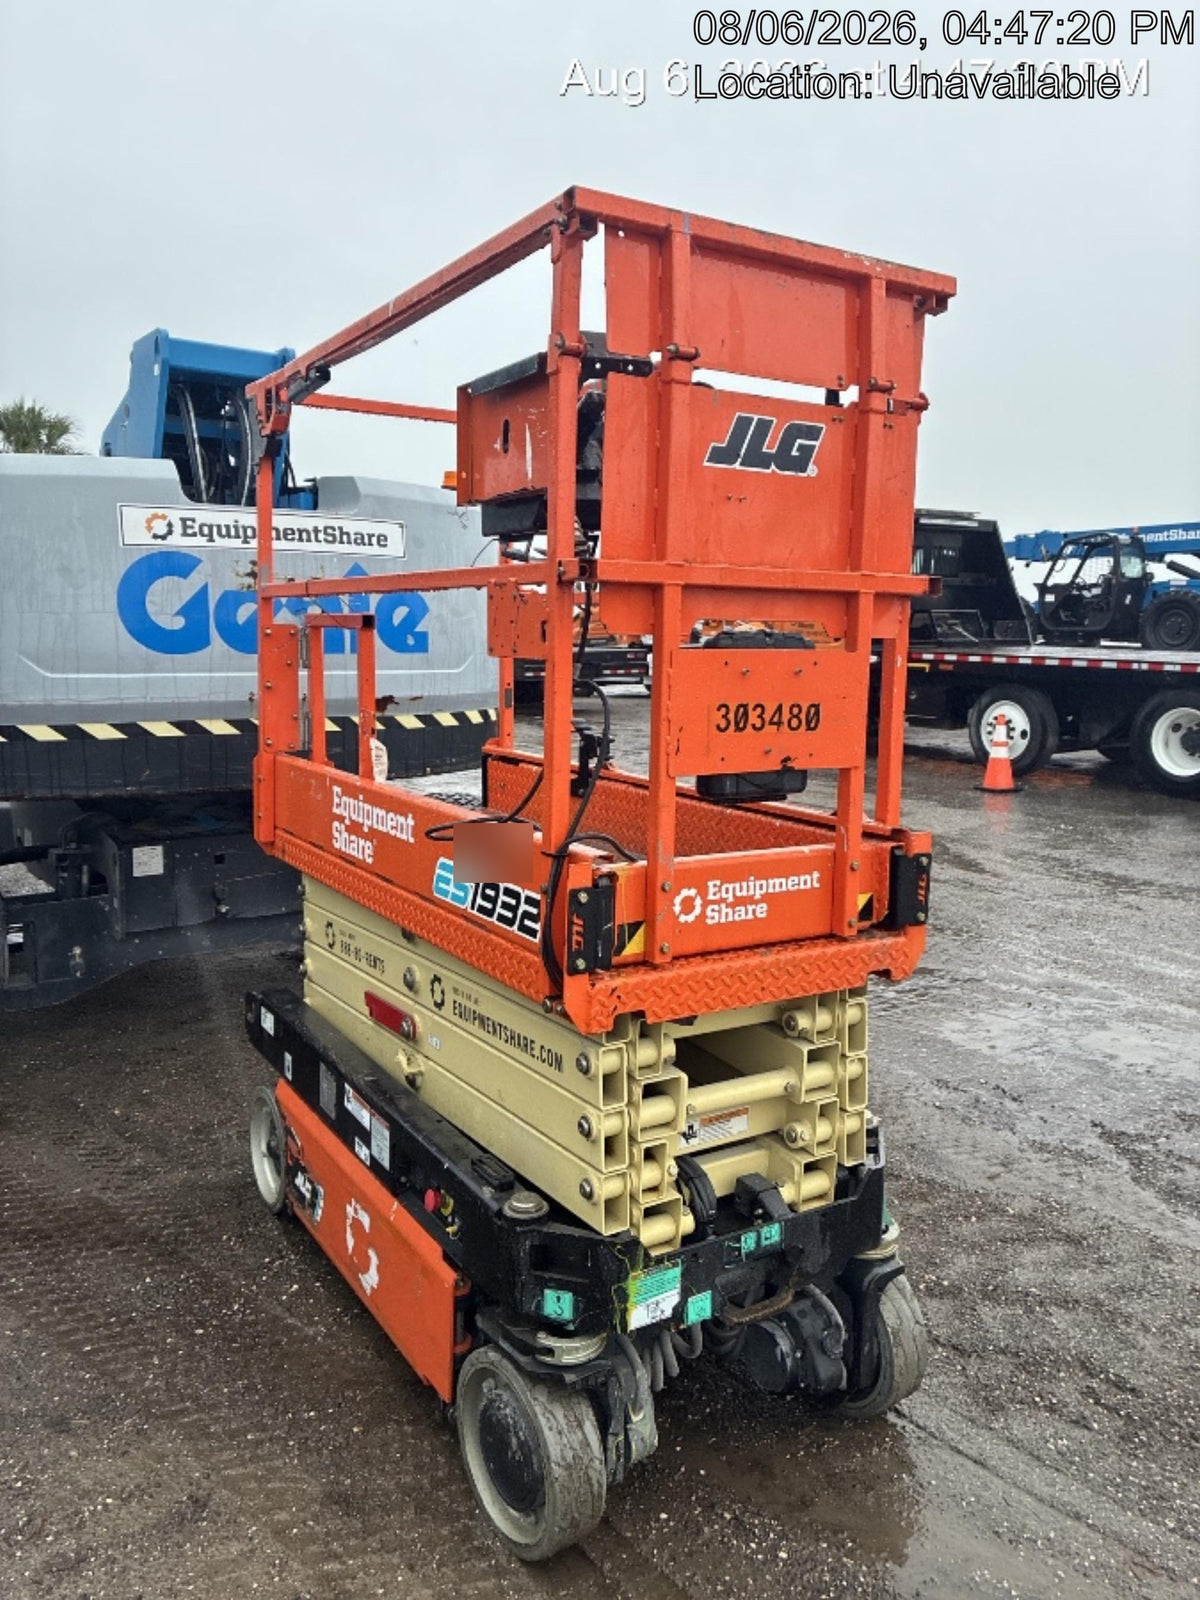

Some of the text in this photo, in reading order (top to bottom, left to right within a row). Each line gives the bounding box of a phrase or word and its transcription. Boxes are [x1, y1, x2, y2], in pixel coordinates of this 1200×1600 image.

[703, 412, 826, 477] JLG
[715, 702, 821, 733] 303480
[332, 785, 415, 843] Equipment
[332, 820, 375, 864] Share
[707, 870, 820, 903] Equipment
[705, 902, 768, 925] Share
[452, 998, 564, 1074] EQUIPMENTSHARE.COM
